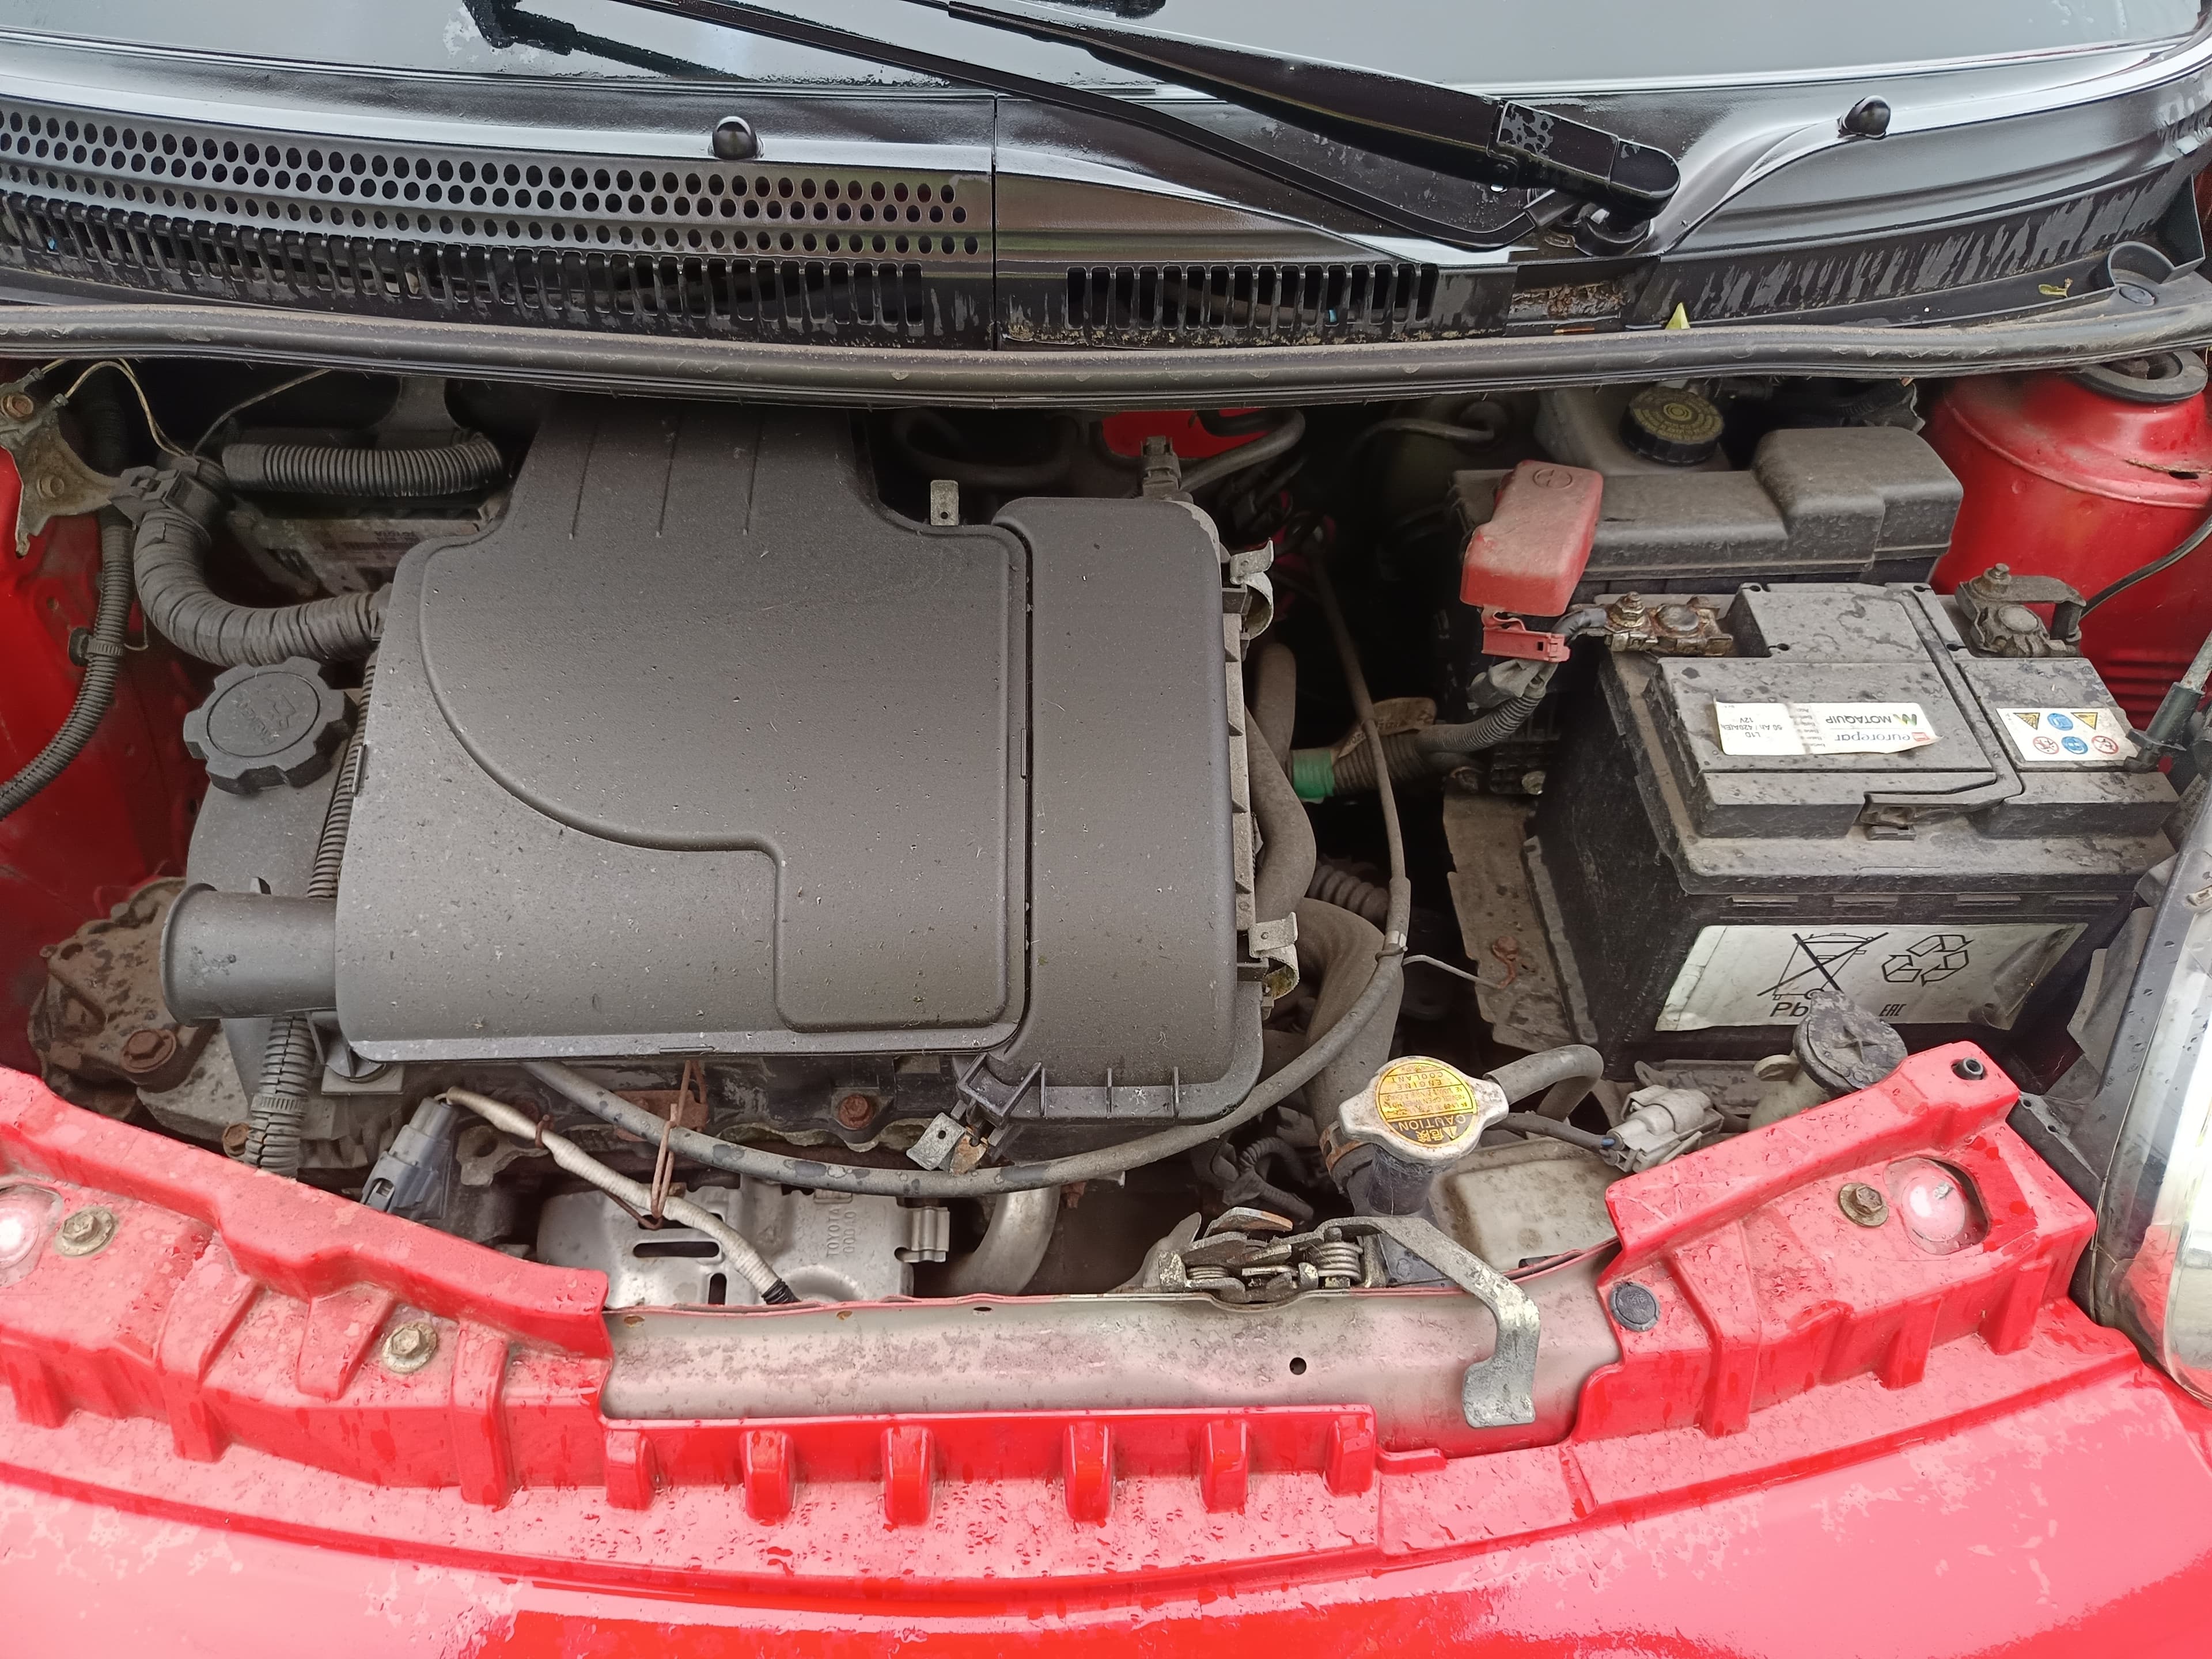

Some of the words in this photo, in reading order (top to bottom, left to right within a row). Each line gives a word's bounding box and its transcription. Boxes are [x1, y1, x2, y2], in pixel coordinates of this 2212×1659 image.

[1825, 715, 1892, 724] MOTAQUIP
[1835, 732, 1910, 741] eurorepar
[1770, 1002, 1809, 1017] Pb
[1391, 1071, 1443, 1084] COOLANT
[1397, 1078, 1442, 1090] ENGINE
[1422, 1096, 1441, 1104] OPEN
[1398, 1114, 1467, 1131] CAUTION
[1415, 1128, 1445, 1143] 危険
[826, 1209, 840, 1258] TOYOTA
